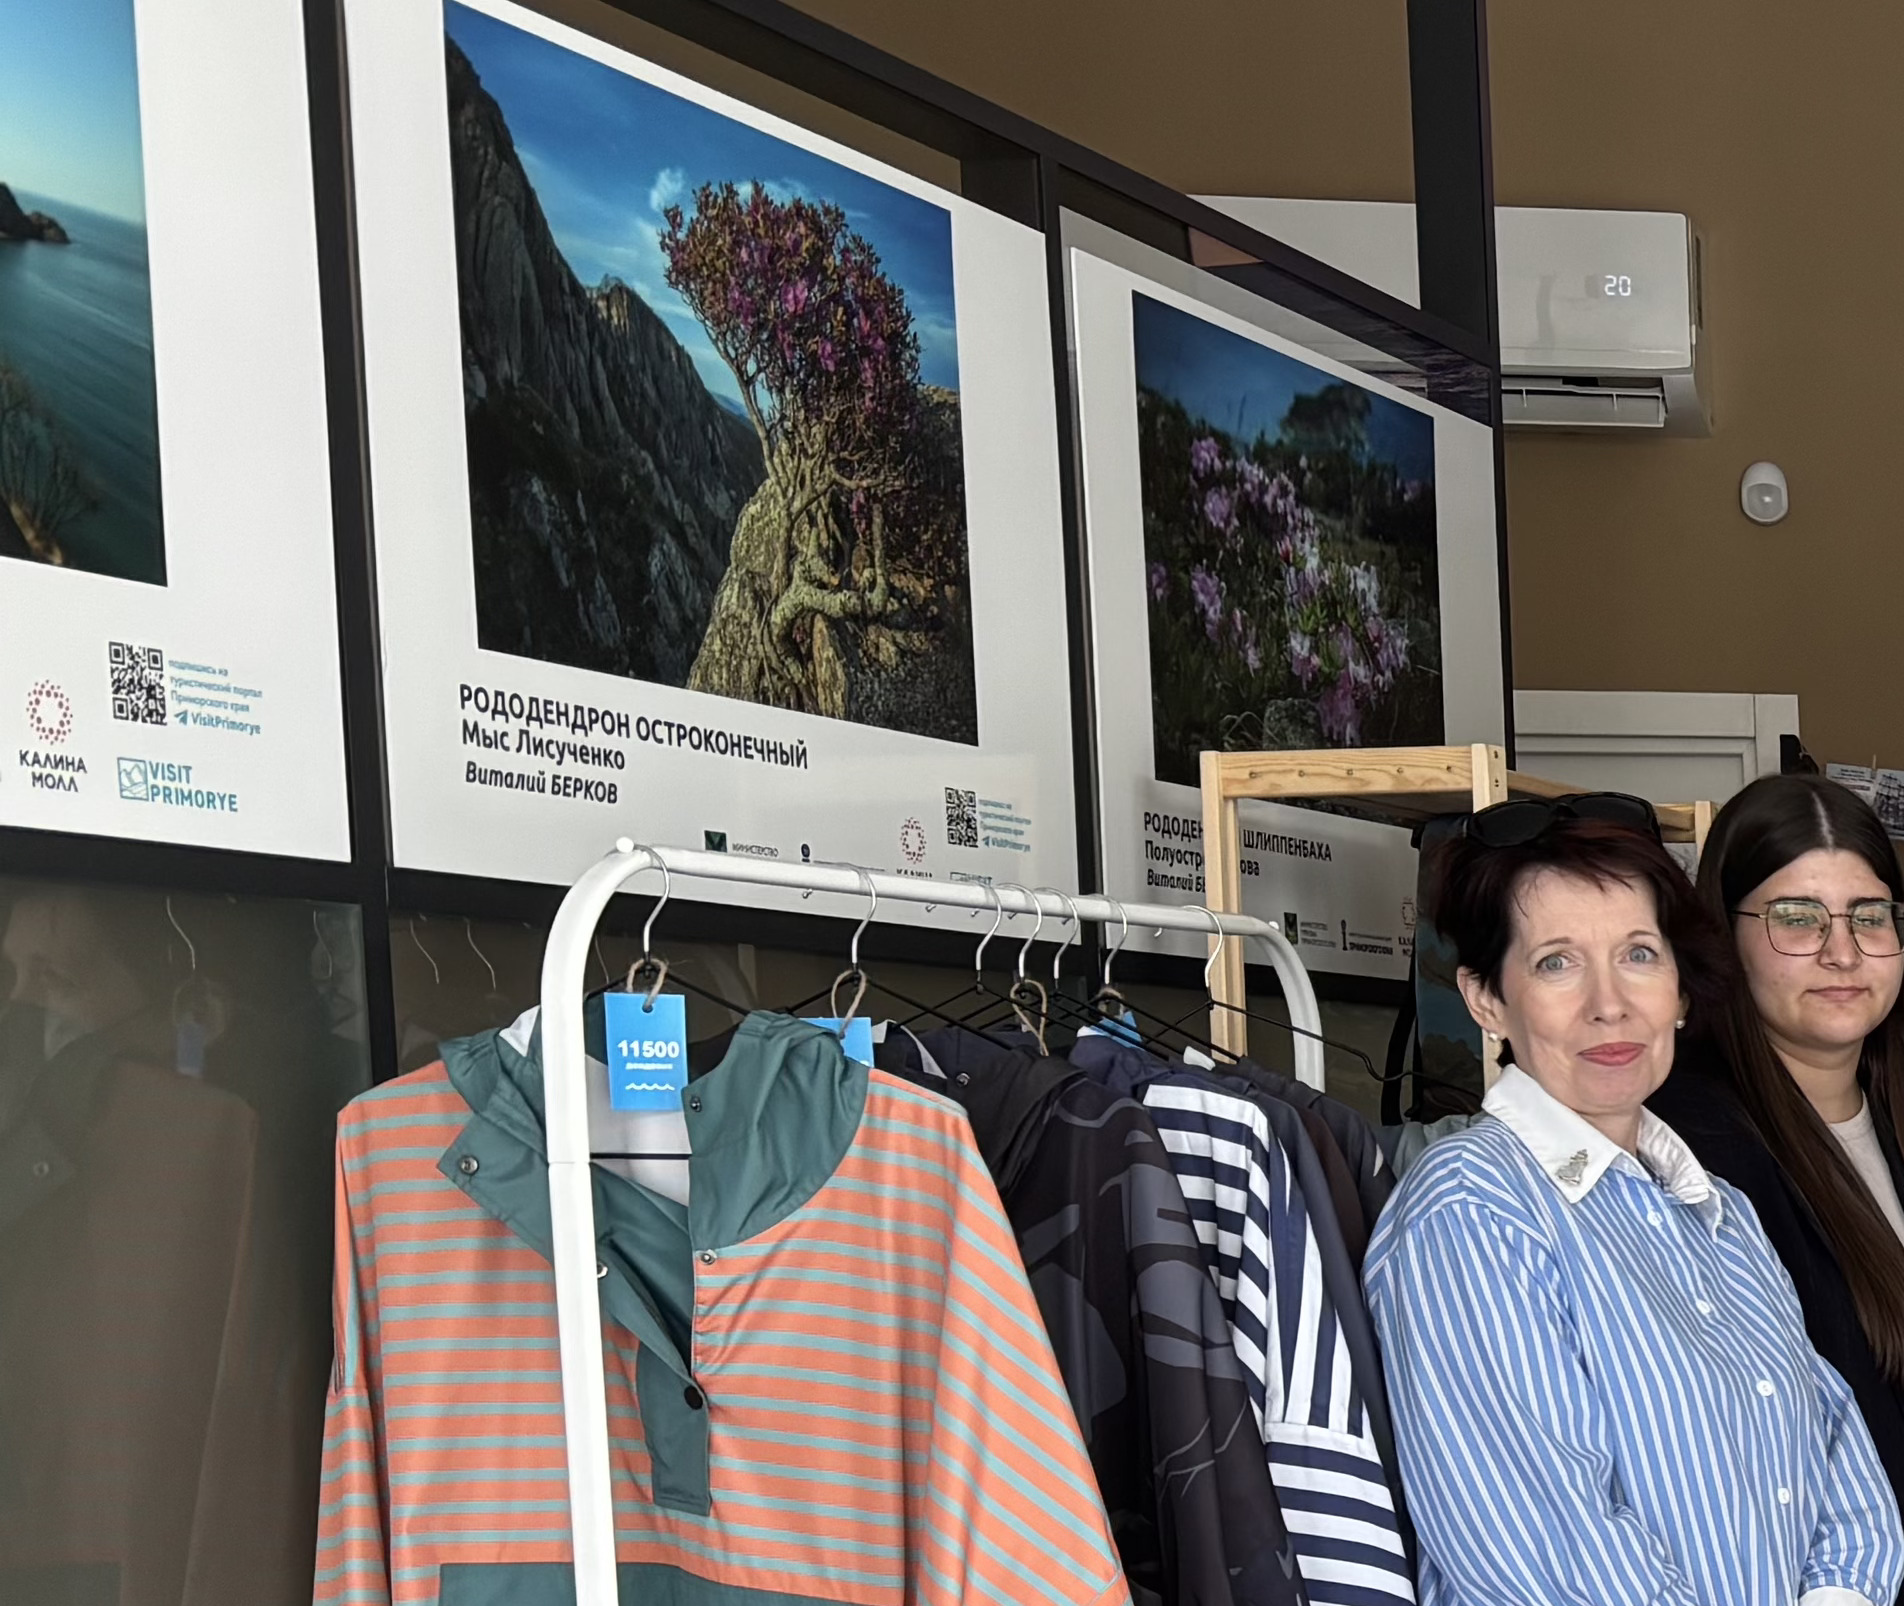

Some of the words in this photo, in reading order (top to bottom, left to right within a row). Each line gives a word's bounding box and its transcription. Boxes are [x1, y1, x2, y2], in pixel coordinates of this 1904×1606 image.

[1604, 275, 1632, 297] 20
[191, 712, 261, 736] VisitPrimorye
[459, 683, 630, 738] РОДОДЕНДРОН
[635, 716, 808, 770] ОСТРОКОНЕЧНЫЙ
[462, 718, 510, 752] Мыс
[516, 728, 626, 771] Лисученко
[19, 749, 88, 775] КАЛИНА
[150, 761, 193, 784] VISIT
[31, 771, 79, 793] МОЛЛ
[465, 760, 546, 794] Виталий
[551, 773, 618, 804] БЕРКОВ
[150, 784, 239, 812] PRIMORYE
[1145, 840, 1205, 871] Полуостр
[1243, 828, 1332, 862] ШЛИППЕНБАХА
[1147, 868, 1194, 892] Виталий
[617, 1039, 680, 1058] 11500
